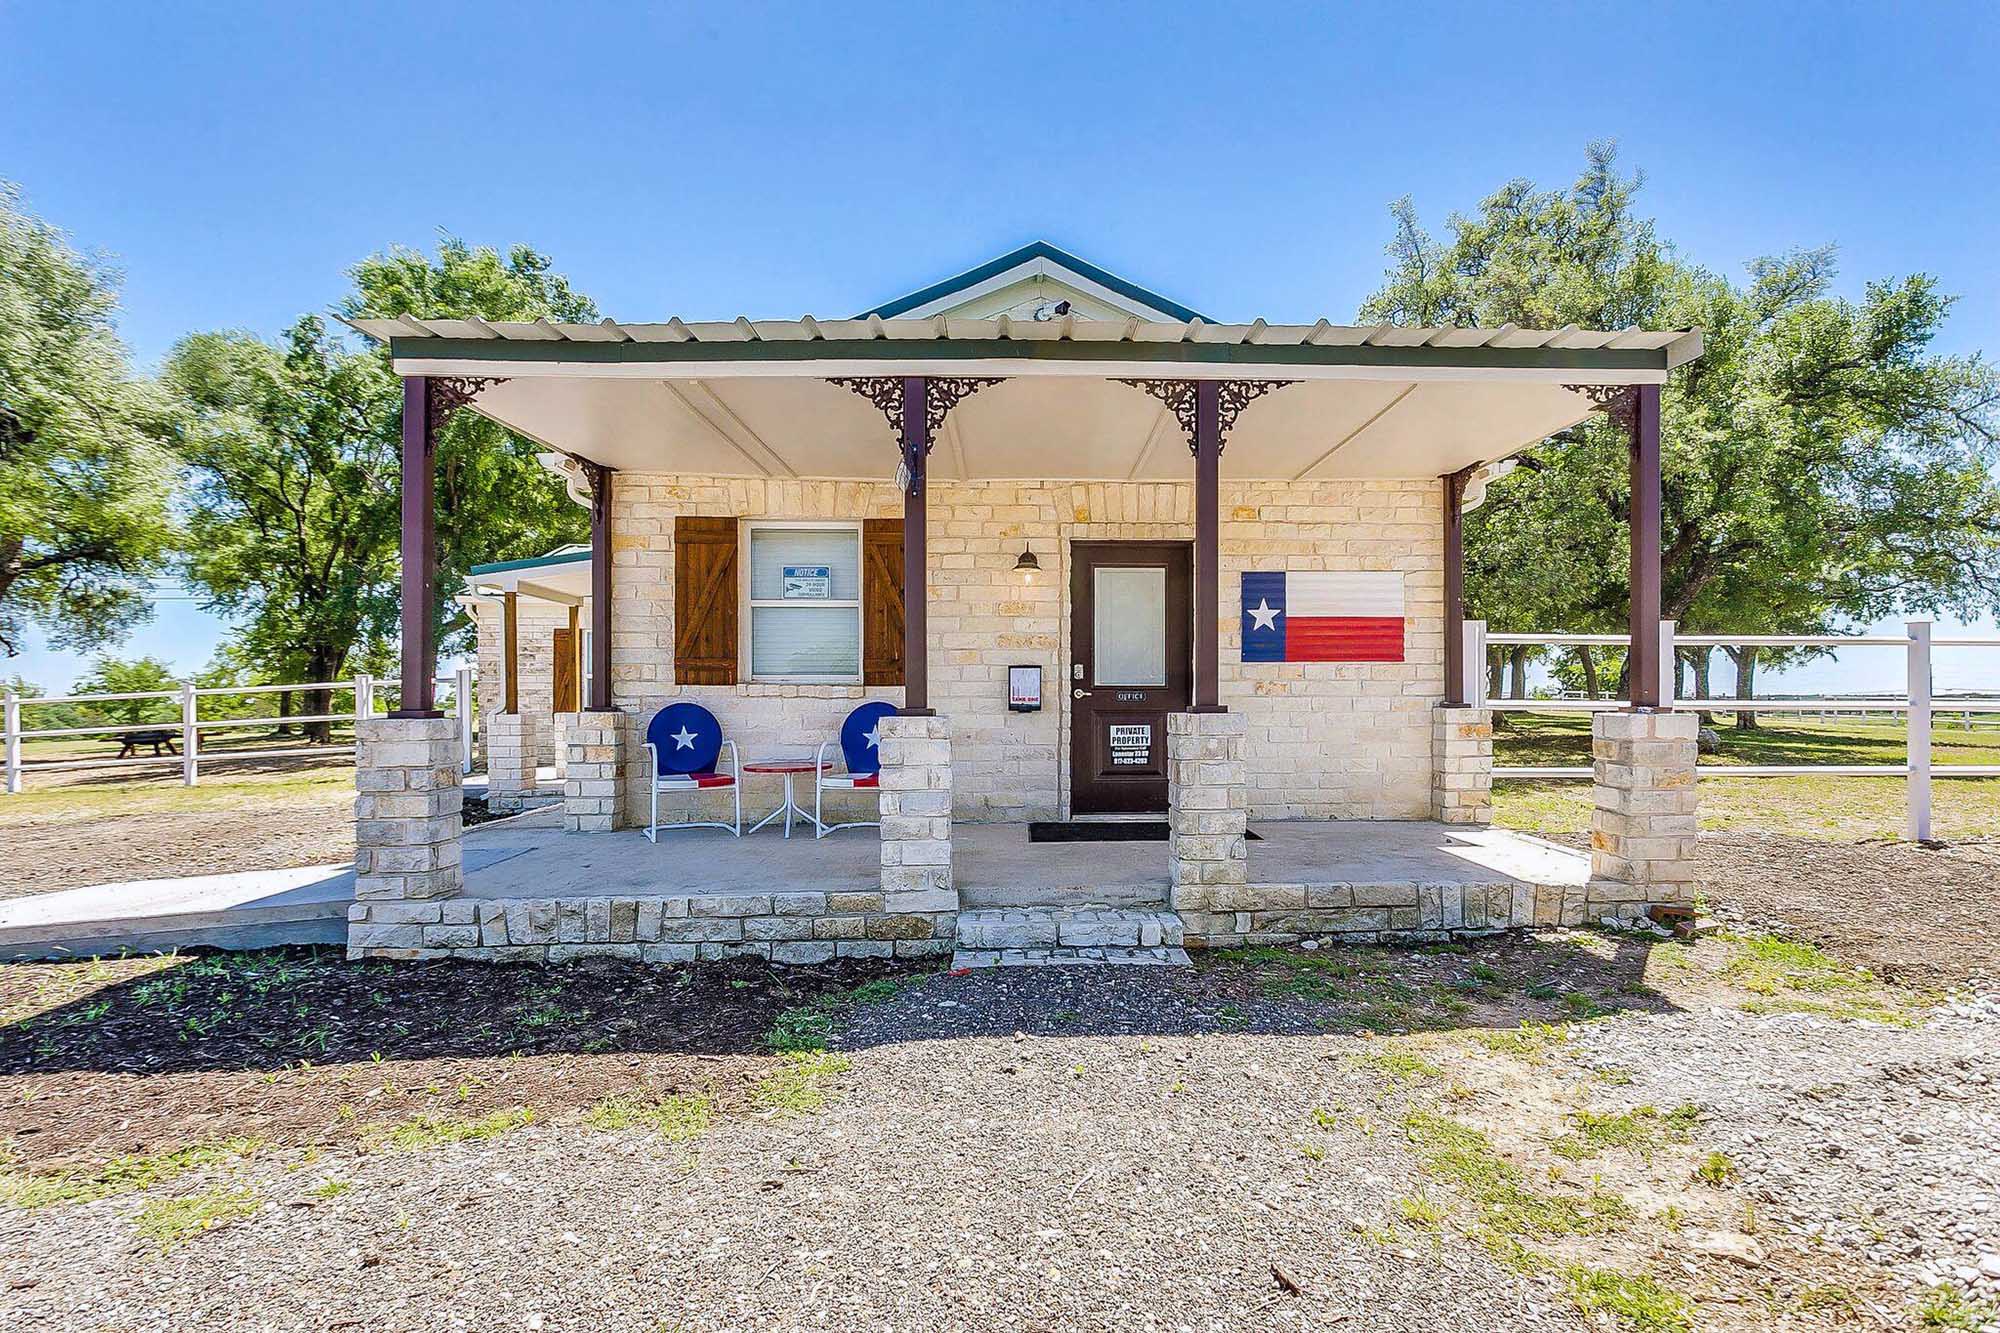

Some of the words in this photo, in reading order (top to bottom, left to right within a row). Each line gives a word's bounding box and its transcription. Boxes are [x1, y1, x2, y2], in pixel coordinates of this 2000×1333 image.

[794, 568, 818, 577] NOTICE
[1115, 727, 1145, 735] PRIVATE
[1112, 736, 1149, 744] PROPERTY
